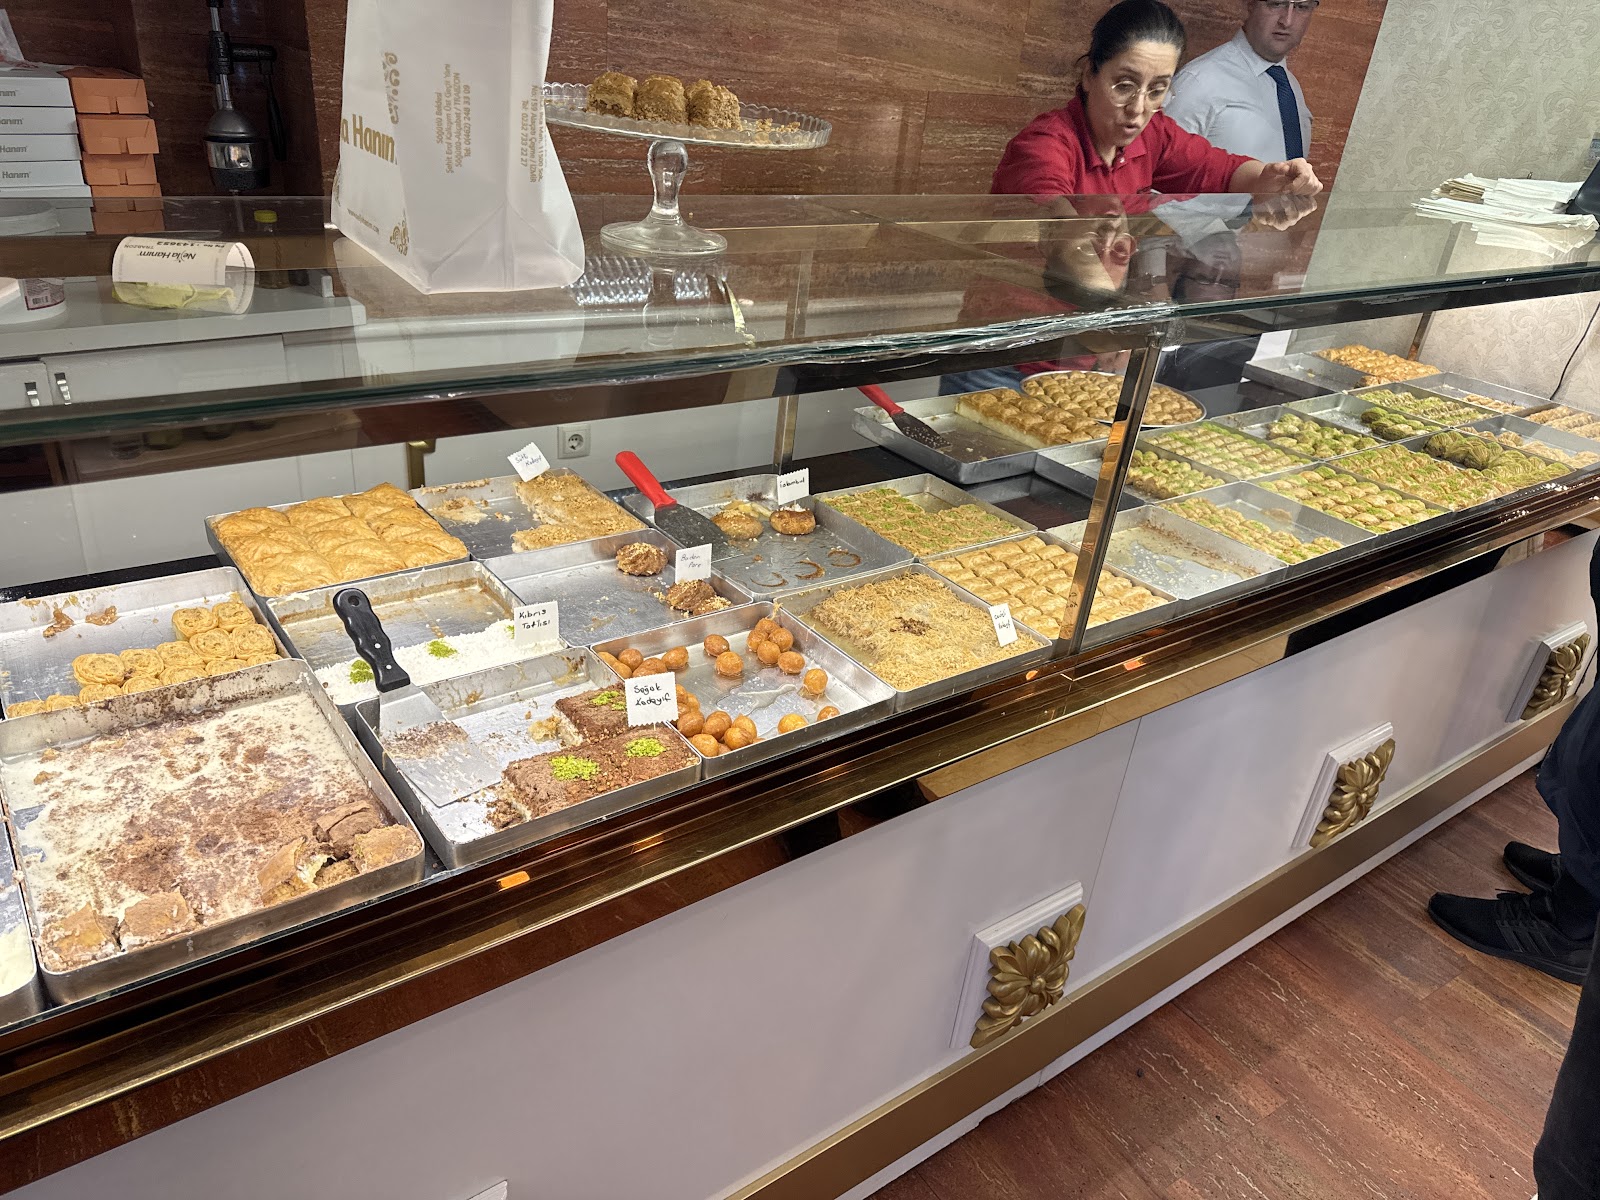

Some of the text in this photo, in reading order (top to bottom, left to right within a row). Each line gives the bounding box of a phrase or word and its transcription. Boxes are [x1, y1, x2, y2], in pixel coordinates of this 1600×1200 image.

[453, 72, 461, 106] TRABZON
[463, 84, 471, 95] 09
[463, 95, 471, 106] 33
[463, 107, 471, 122] 248
[521, 147, 528, 157] 22
[528, 137, 537, 159] Çeşme
[520, 156, 528, 168] 27
[2, 171, 30, 179] Hanım
[529, 164, 538, 183] İZMİR
[139, 250, 171, 259] Hanım
